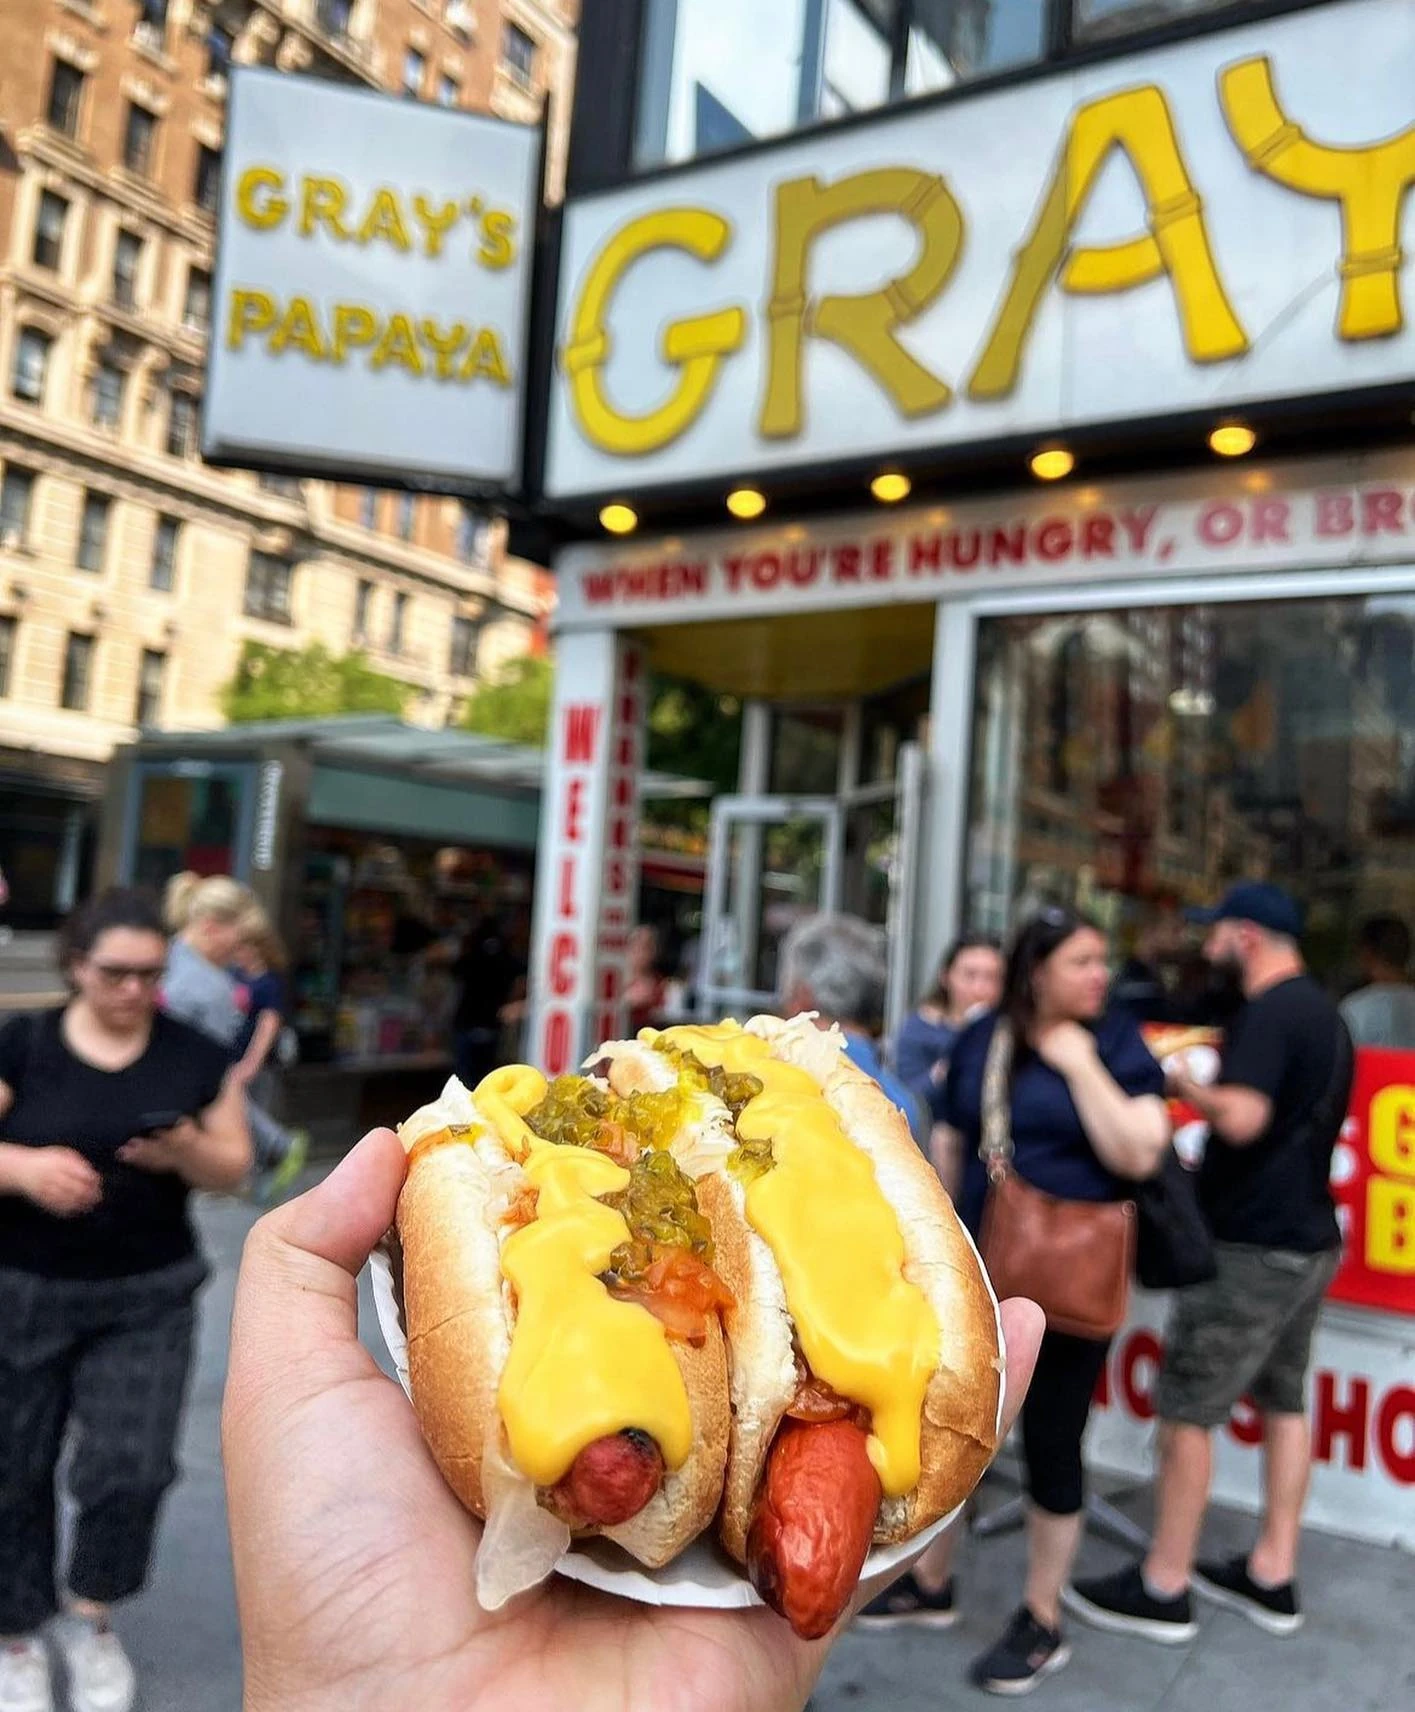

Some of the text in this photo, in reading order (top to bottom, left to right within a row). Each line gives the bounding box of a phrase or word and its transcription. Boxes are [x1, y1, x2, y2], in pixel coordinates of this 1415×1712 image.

[226, 289, 512, 385] PAPAYA
[584, 561, 708, 605] WHEN
[908, 505, 1176, 576] HUNGRY,
[1197, 496, 1290, 546] OR
[1314, 490, 1415, 537] BR
